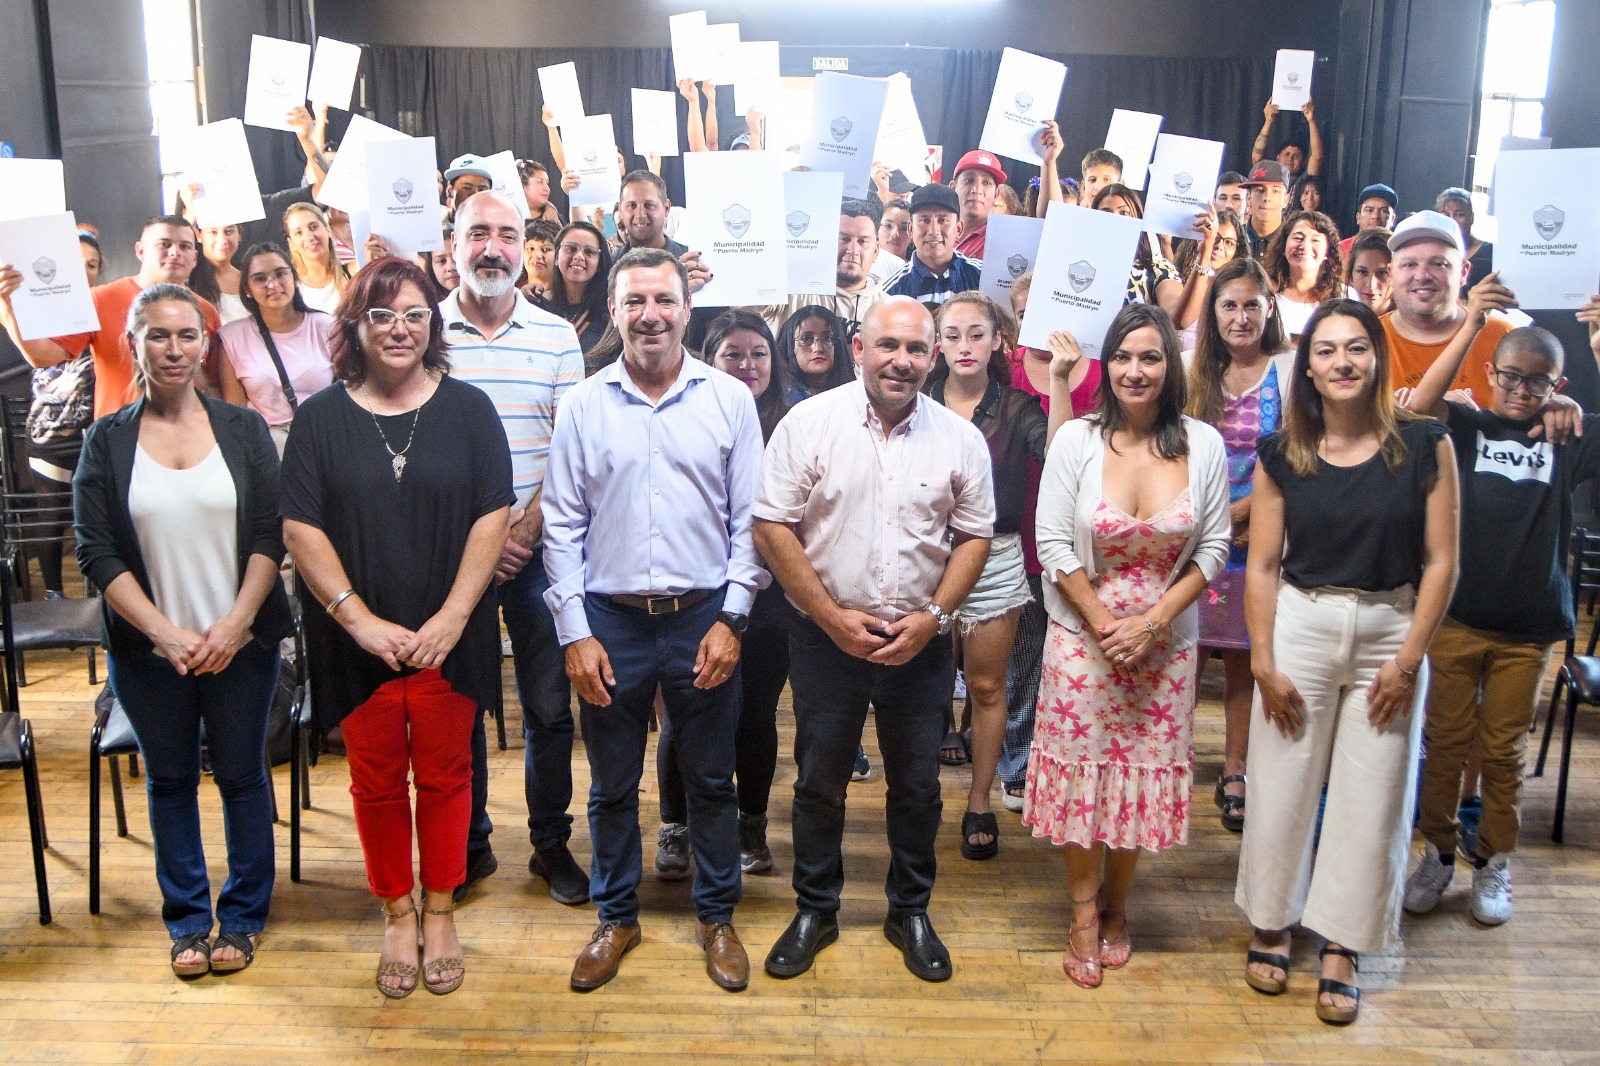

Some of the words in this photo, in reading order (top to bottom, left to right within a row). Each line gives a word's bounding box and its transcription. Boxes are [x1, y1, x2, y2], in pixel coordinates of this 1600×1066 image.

[815, 59, 848, 69] SALIDA
[1053, 290, 1102, 306] Municipalidad
[1055, 297, 1075, 306] Puerto
[1076, 302, 1099, 311] Madryn
